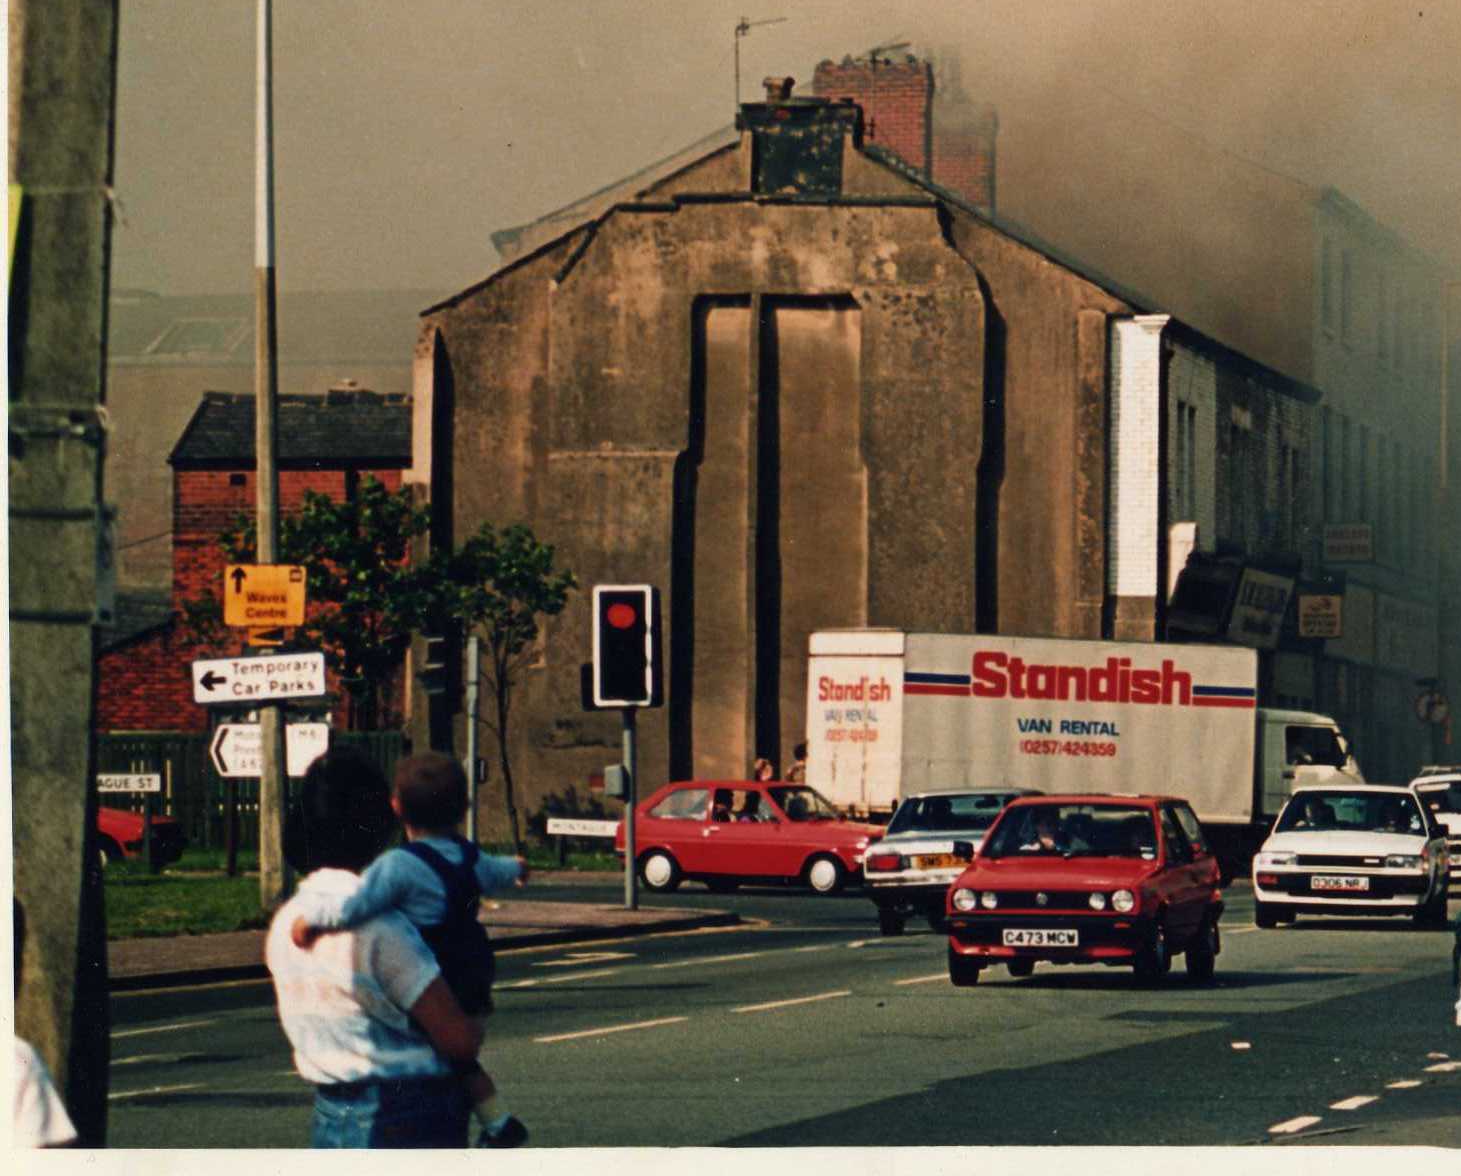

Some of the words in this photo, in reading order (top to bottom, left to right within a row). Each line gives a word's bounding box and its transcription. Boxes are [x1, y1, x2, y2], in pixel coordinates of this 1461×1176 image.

[246, 591, 287, 603] Waves
[245, 607, 287, 619] Centre
[231, 660, 319, 676] Temporary
[972, 651, 1192, 706] Standish
[231, 681, 261, 696] Car
[269, 679, 315, 692] Parks
[818, 674, 892, 702] Standsh
[1017, 718, 1052, 733] VAN
[1060, 720, 1120, 737] RENTAL
[138, 777, 153, 789] ST
[1005, 931, 1043, 945] C473
[1046, 931, 1076, 945] MCW
